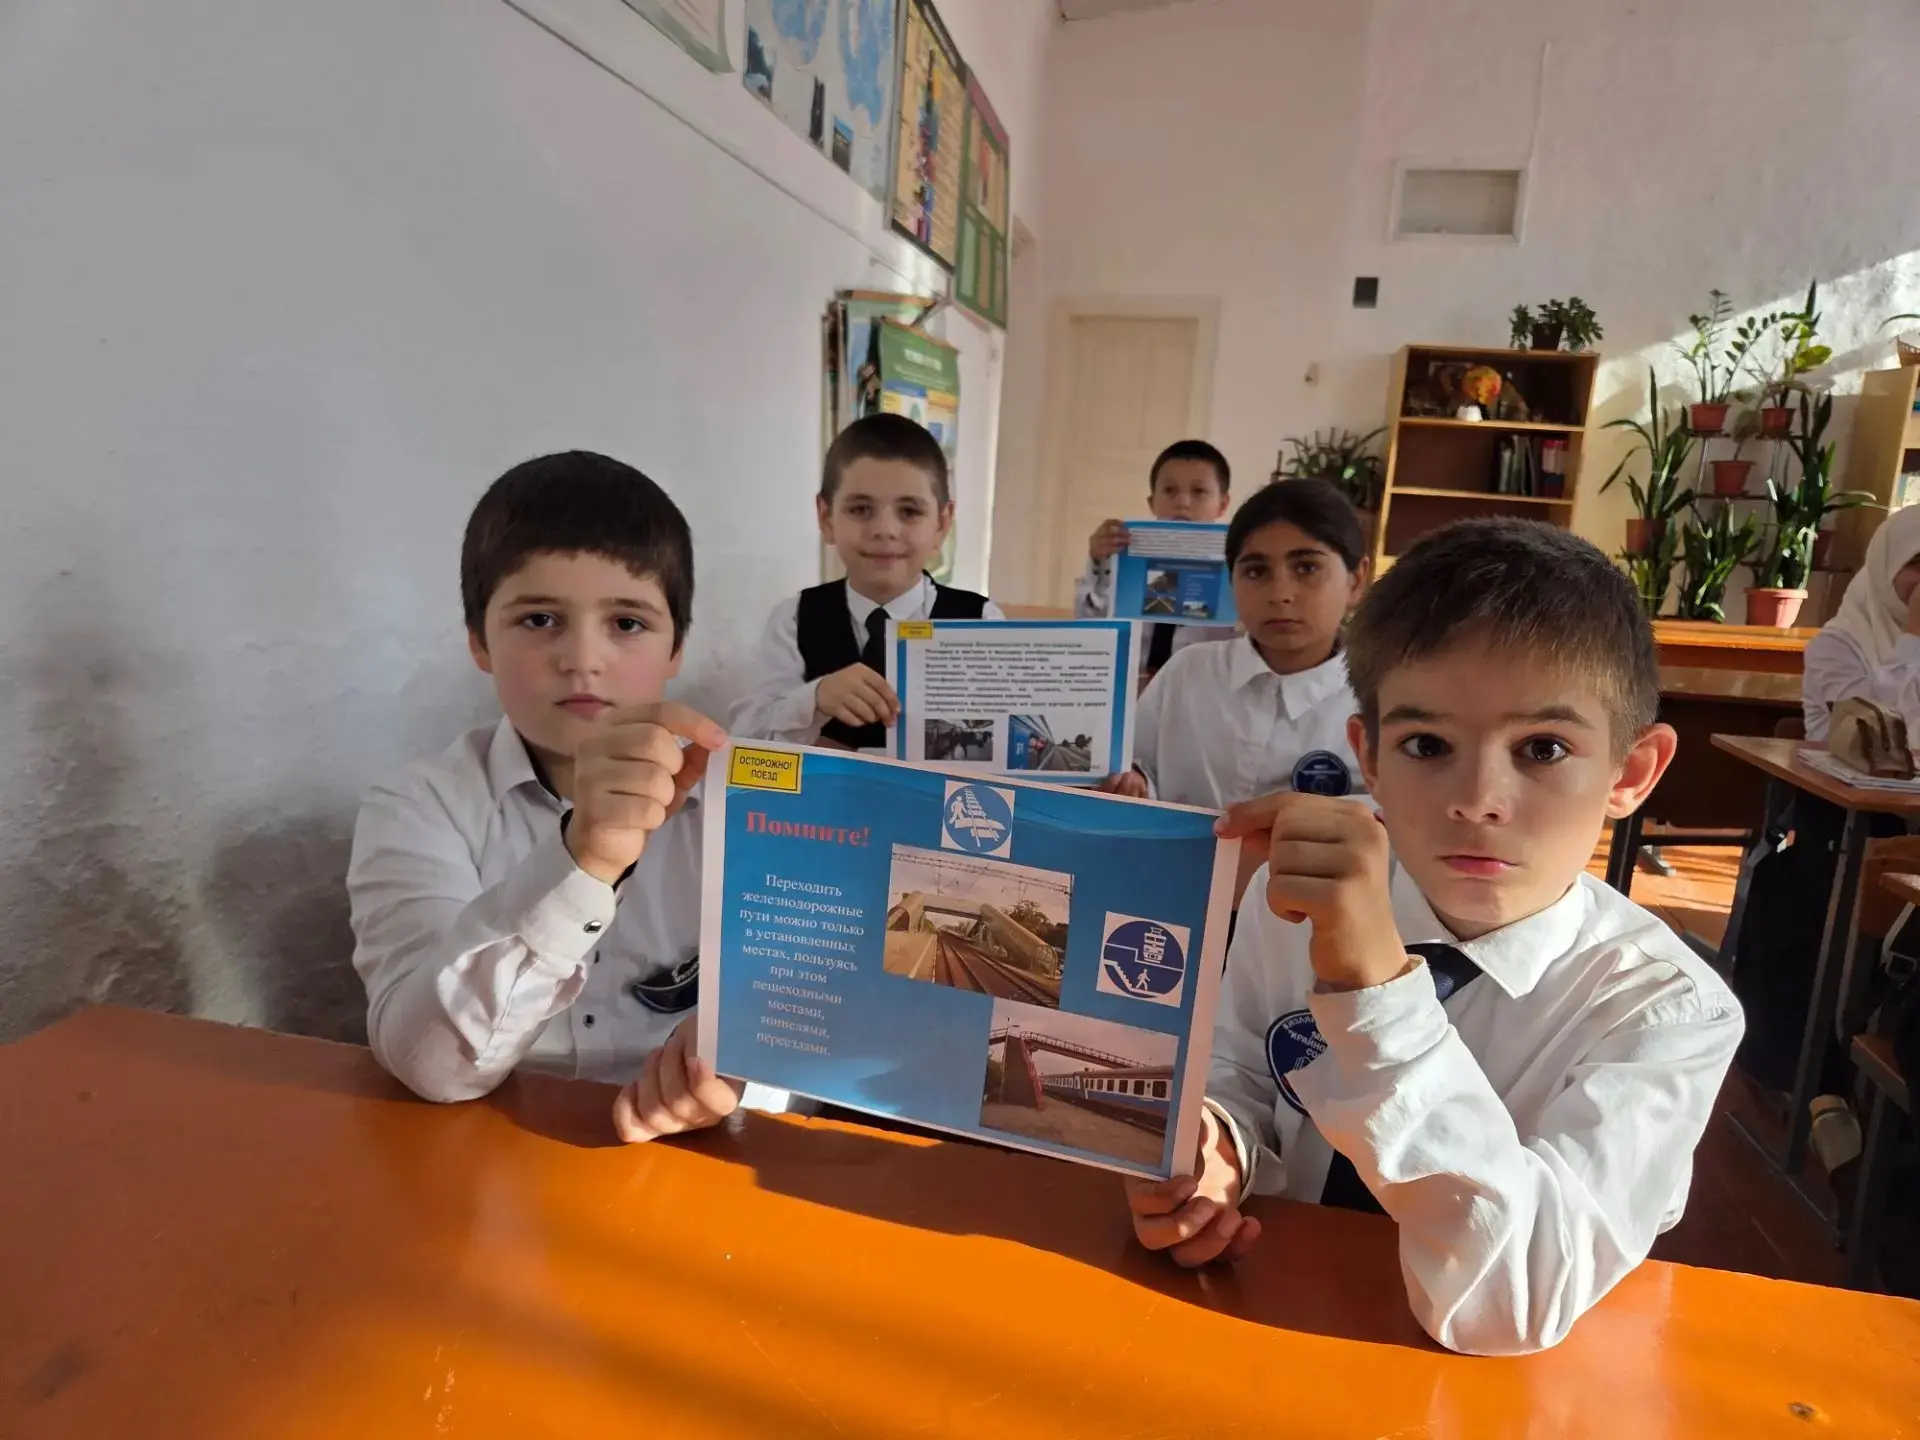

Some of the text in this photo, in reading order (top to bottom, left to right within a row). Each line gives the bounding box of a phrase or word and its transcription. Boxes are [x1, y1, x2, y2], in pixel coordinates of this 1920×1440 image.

[739, 755, 793, 770] ОСТОРОЖНО!
[751, 769, 778, 782] ПОЕЗД
[745, 810, 871, 848] Помните!
[765, 873, 842, 897] Переходить
[742, 891, 864, 918] железнодорожные
[739, 908, 865, 937] пути можно только
[745, 927, 857, 954] в установленных
[742, 944, 858, 972] местах, пользуясь
[770, 964, 828, 984] при этом
[752, 979, 842, 1005] пешеходными
[768, 999, 825, 1021] мостами,
